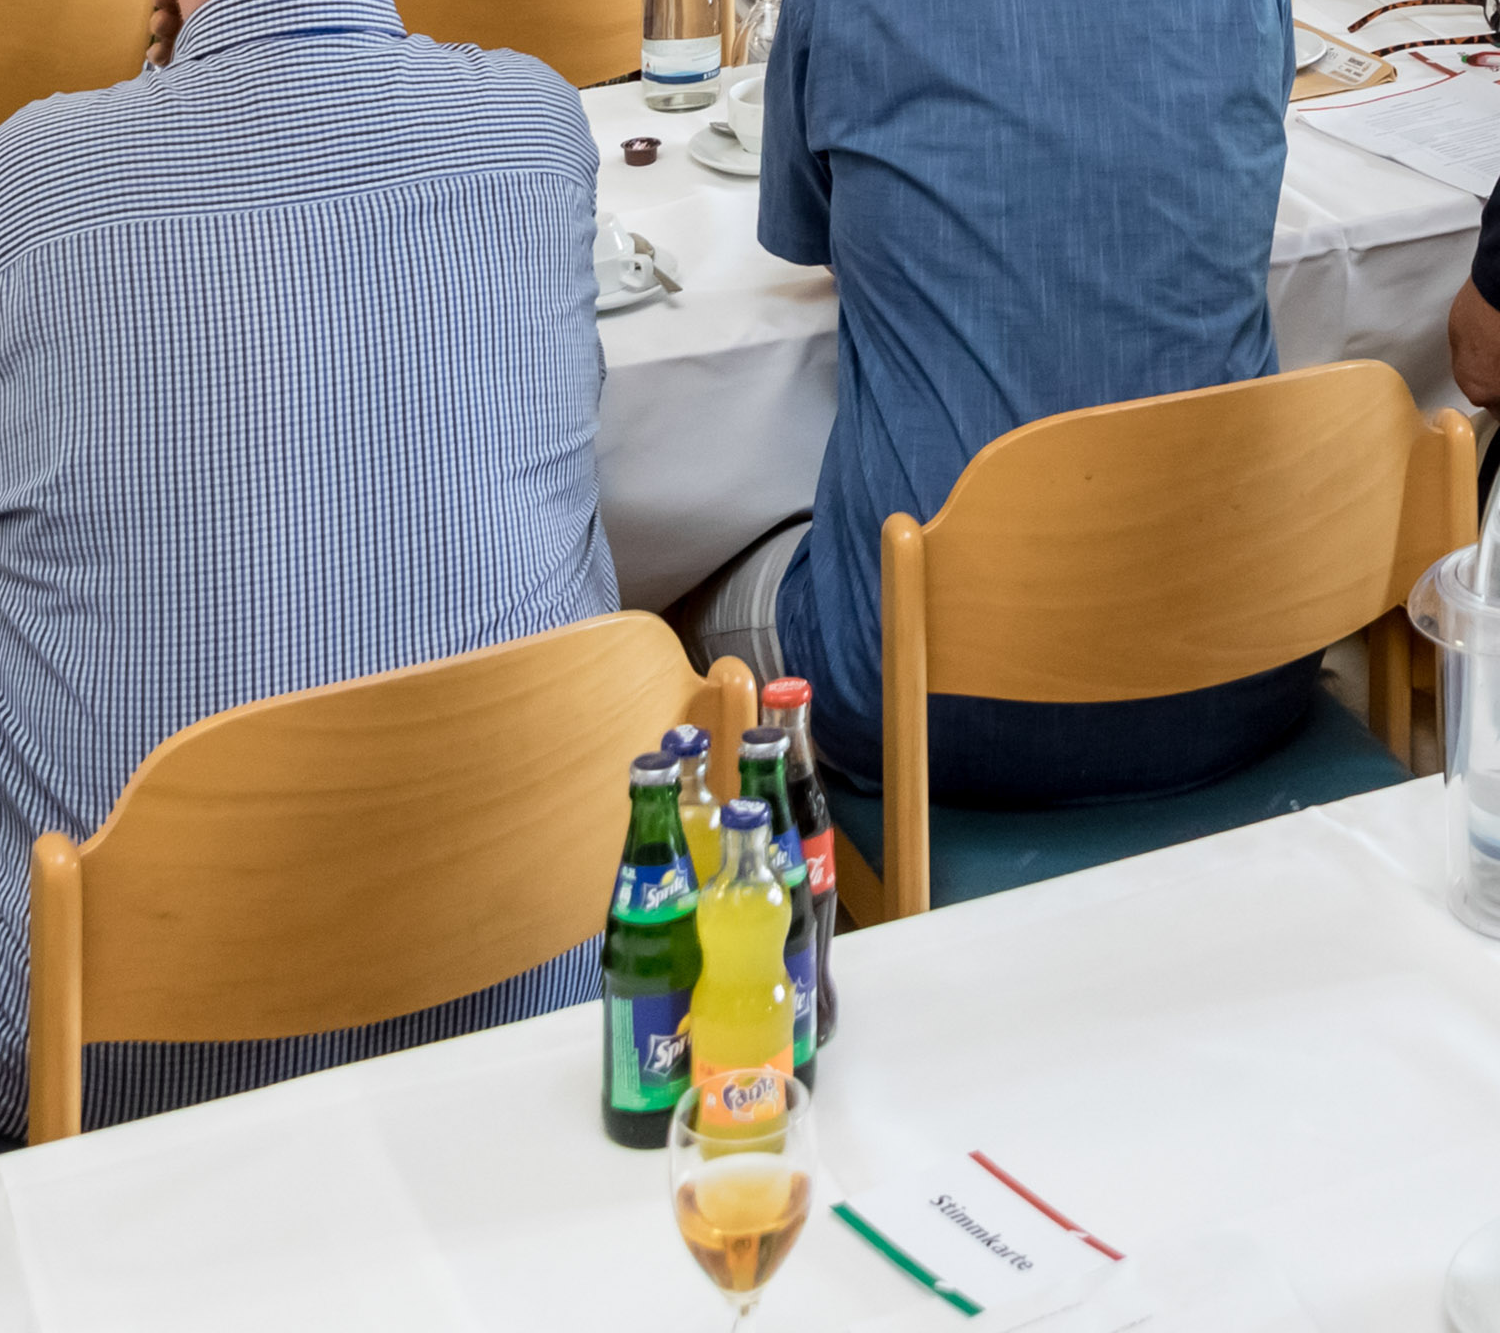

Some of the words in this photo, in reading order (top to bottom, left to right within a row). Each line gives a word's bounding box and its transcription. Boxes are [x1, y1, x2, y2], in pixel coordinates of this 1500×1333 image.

[644, 876, 685, 910] Sprite
[722, 1076, 776, 1111] Fanta
[929, 1193, 1034, 1271] Stimmkarte
